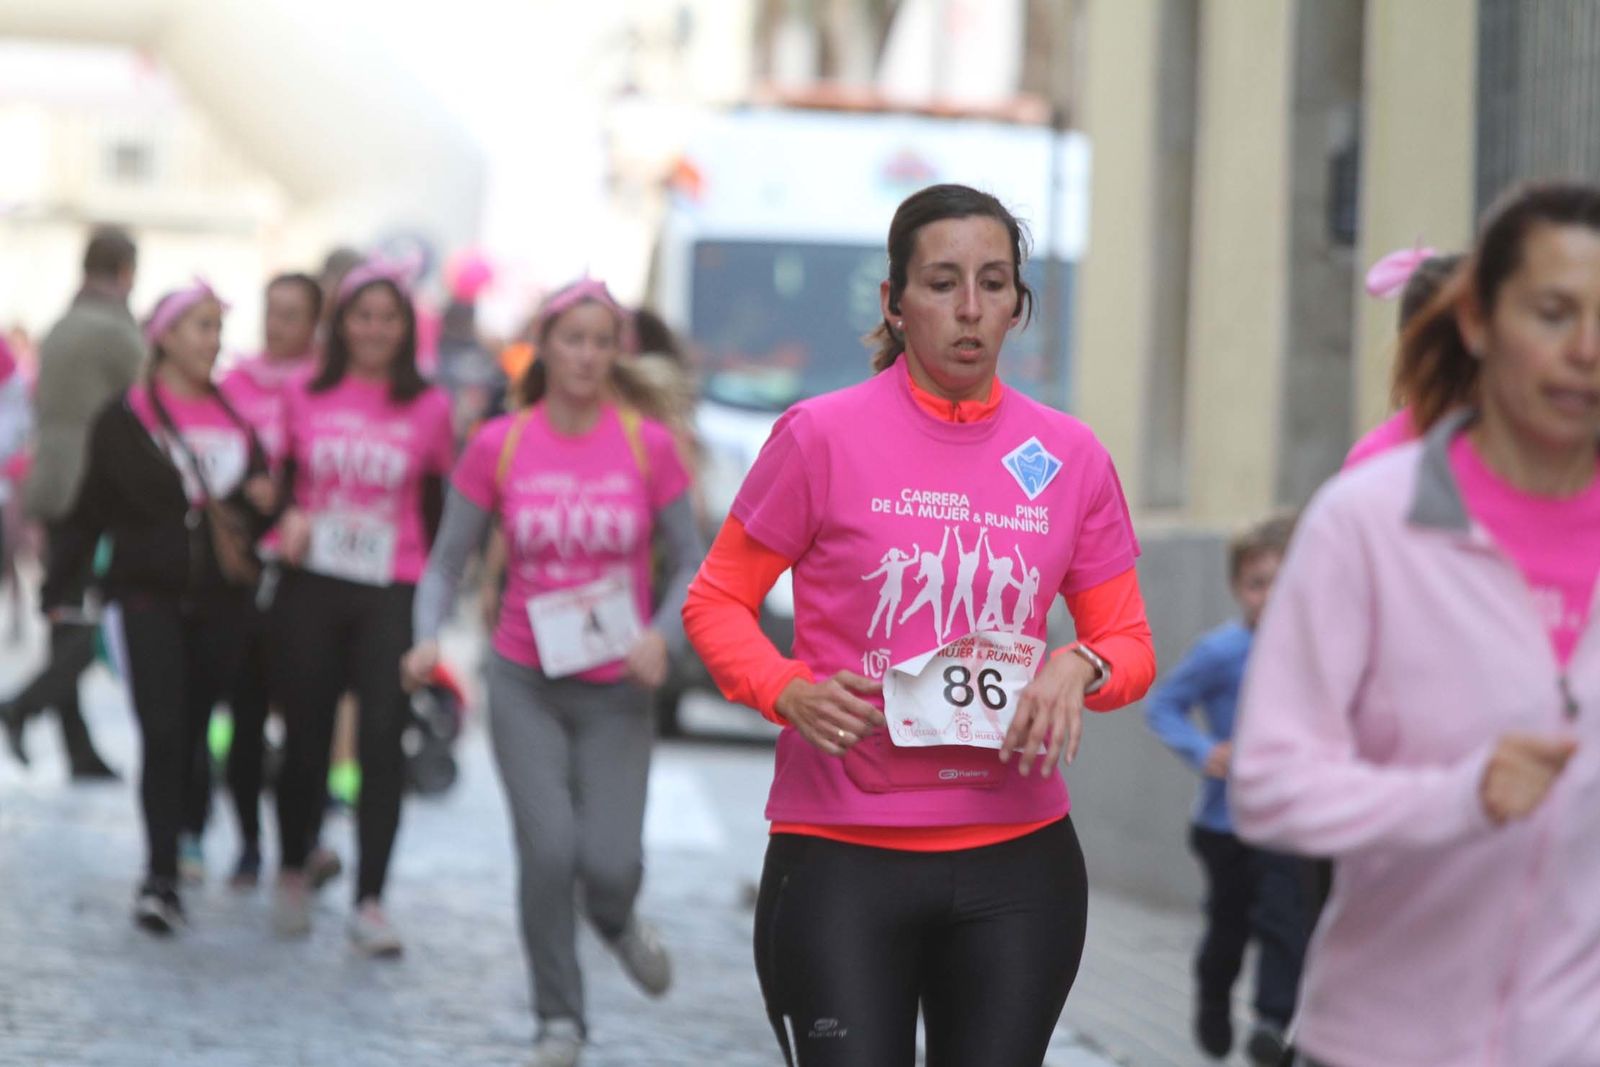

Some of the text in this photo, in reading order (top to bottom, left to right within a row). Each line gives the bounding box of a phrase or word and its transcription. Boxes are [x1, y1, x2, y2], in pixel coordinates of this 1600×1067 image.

[871, 498, 1049, 535] DE LA MUJER & RUNNING
[901, 488, 1049, 520] CARRERA PINK
[943, 665, 1007, 710] 86
